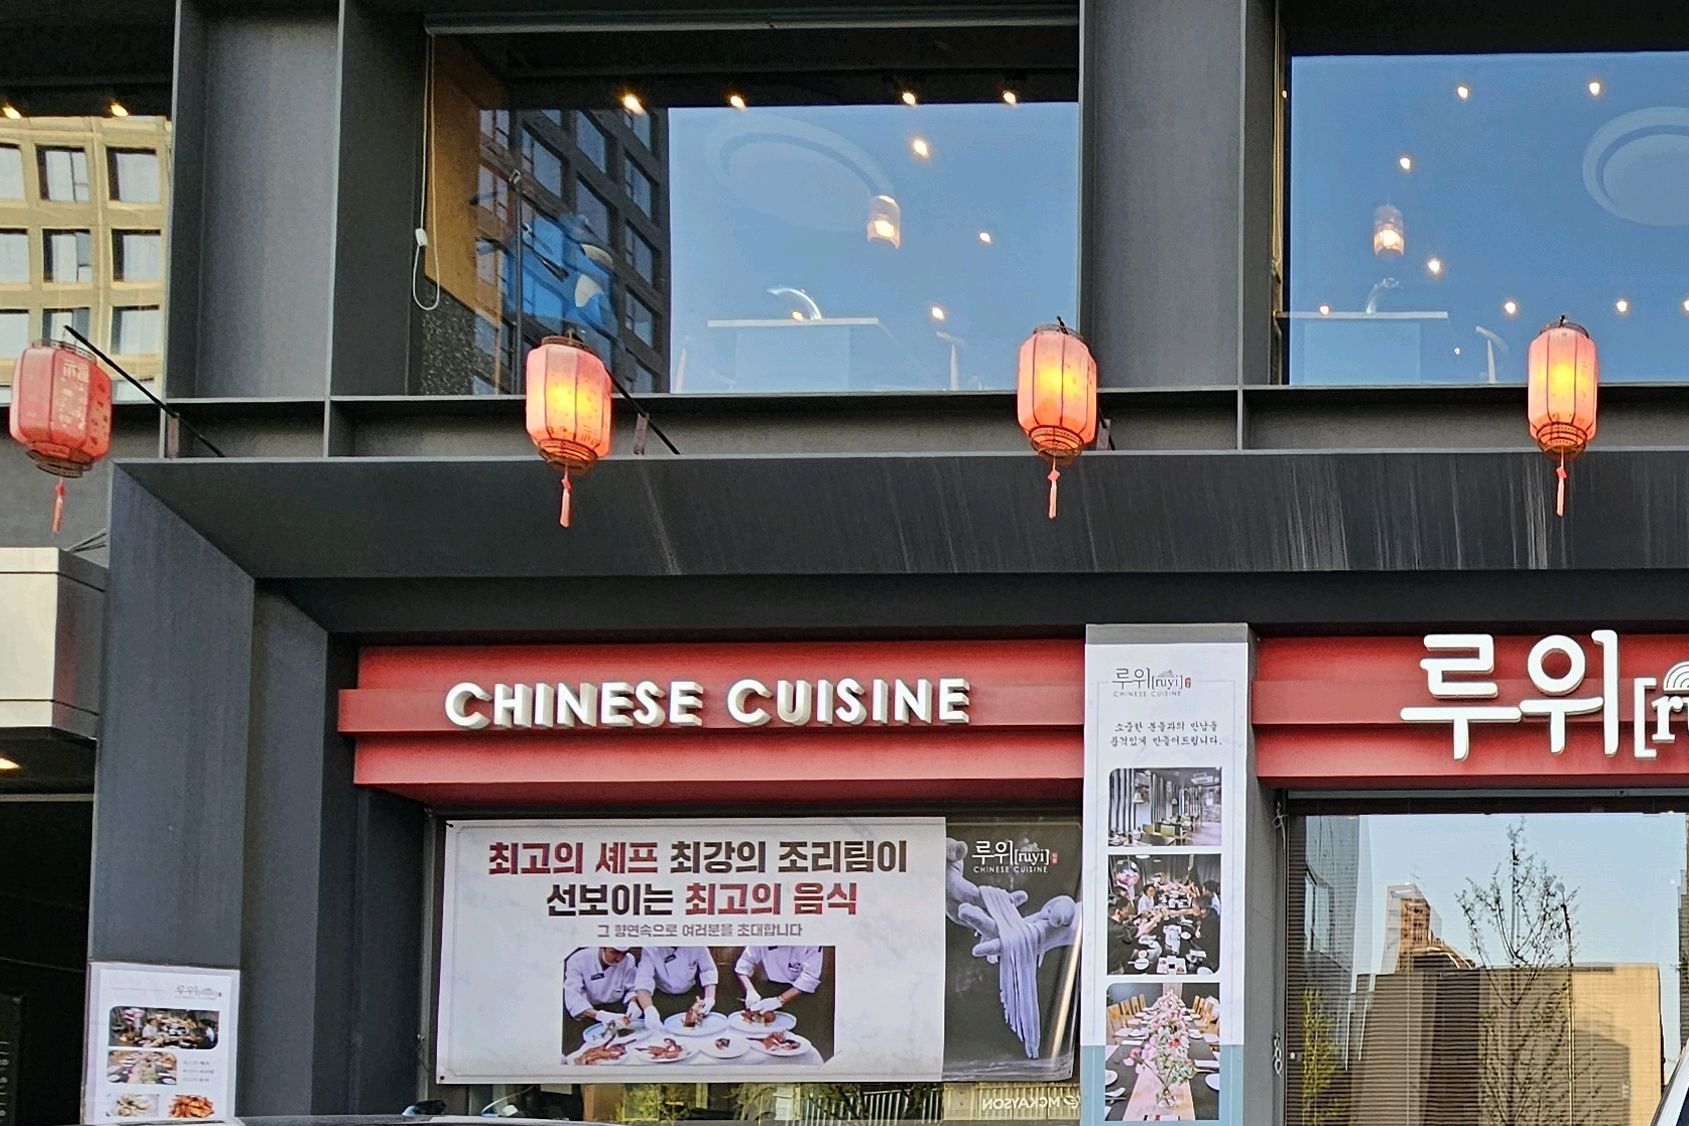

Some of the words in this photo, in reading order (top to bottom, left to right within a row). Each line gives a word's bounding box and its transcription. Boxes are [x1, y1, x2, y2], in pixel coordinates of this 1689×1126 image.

[1112, 667, 1150, 690] 루위
[444, 681, 703, 730] CHINESE
[727, 677, 970, 726] CUISINE
[1400, 629, 1618, 761] 루위
[489, 842, 584, 875] 최고의
[596, 841, 658, 874] 셰프
[670, 840, 766, 873] 최강의
[778, 839, 907, 873] 조리팀이
[971, 840, 1013, 865] 루위
[1013, 865, 1048, 873] CUISINE
[547, 884, 673, 916] 선보이는
[685, 883, 781, 915] 최고의
[793, 882, 858, 915] 음식
[597, 925, 610, 937] 그
[614, 924, 678, 937] 향연속으로
[682, 924, 734, 937] 여러분을
[737, 923, 803, 937] 초대합니다
